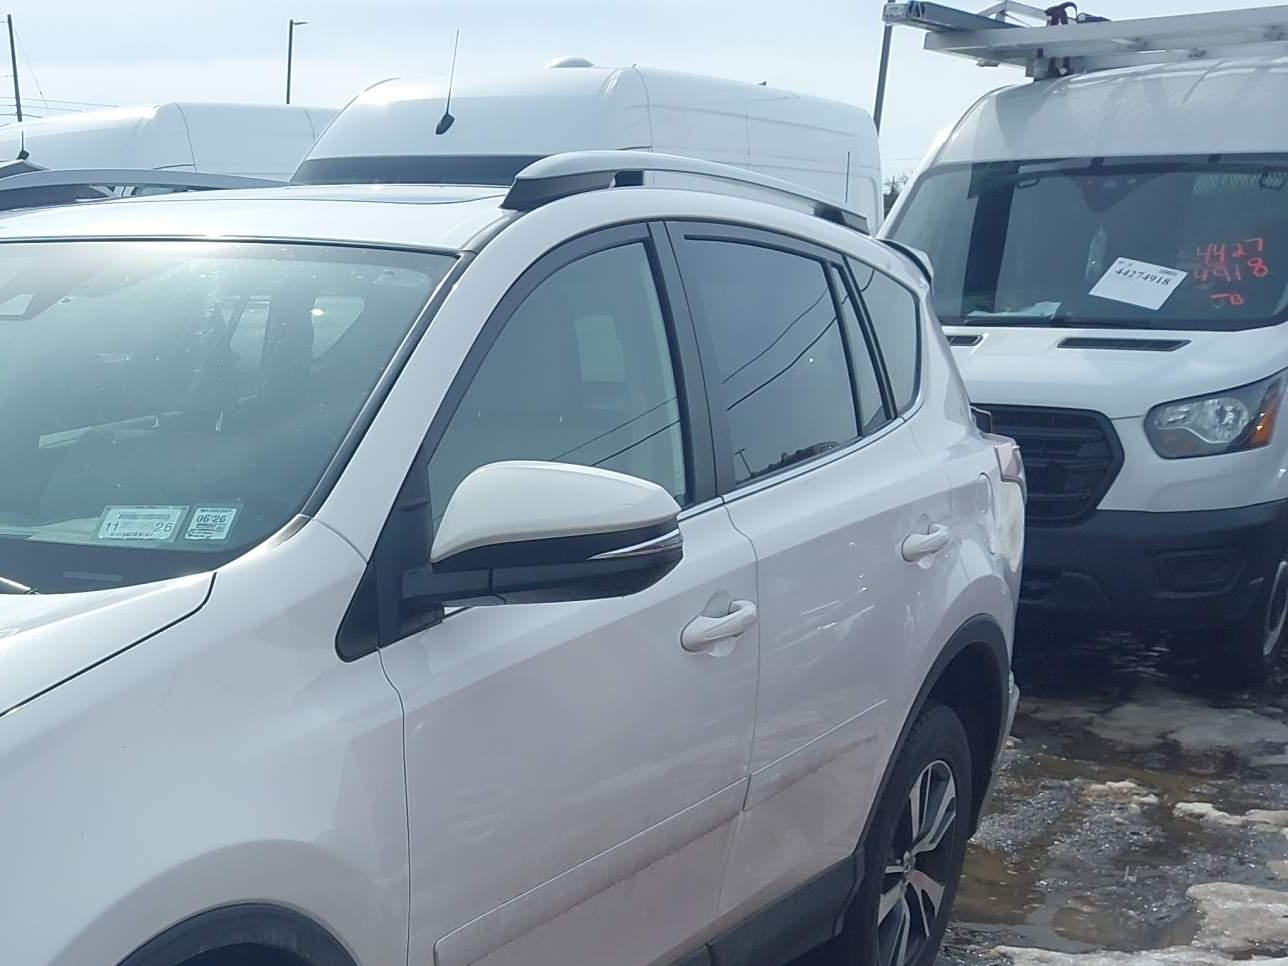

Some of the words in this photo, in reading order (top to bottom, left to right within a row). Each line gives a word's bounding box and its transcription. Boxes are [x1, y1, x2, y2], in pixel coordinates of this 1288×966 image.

[1115, 267, 1171, 285] 44274918
[105, 521, 120, 532] 11
[154, 522, 174, 533] 26
